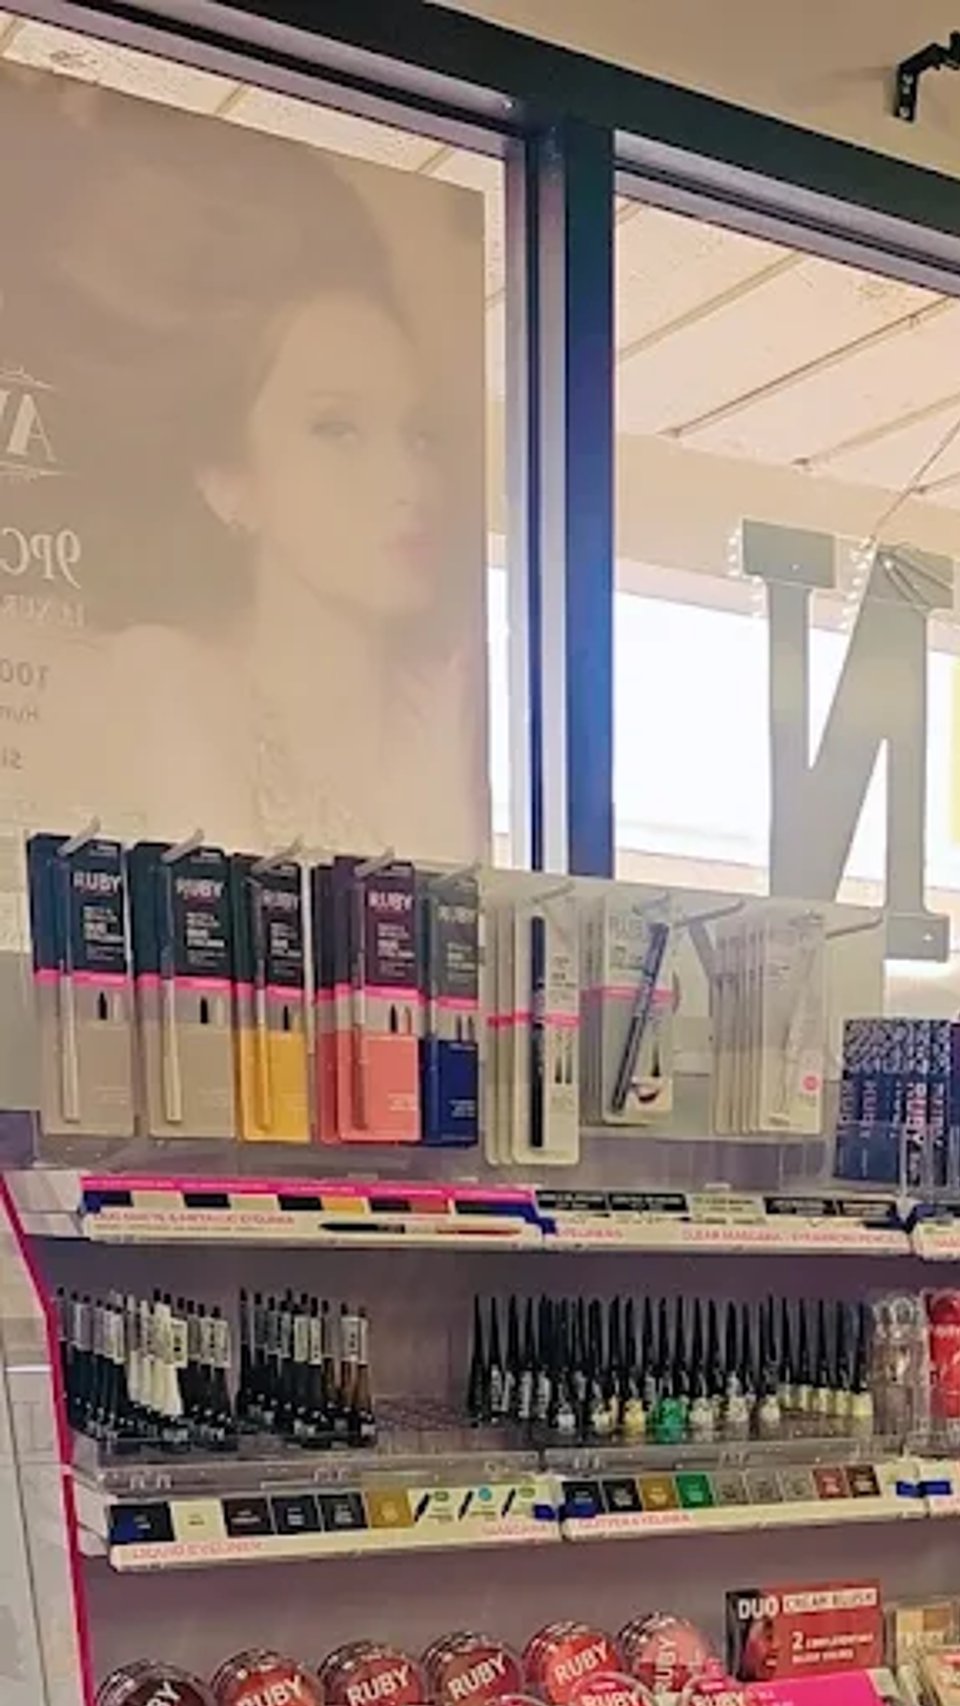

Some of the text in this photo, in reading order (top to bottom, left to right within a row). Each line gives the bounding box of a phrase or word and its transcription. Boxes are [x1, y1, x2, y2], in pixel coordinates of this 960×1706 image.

[73, 871, 122, 893] RUBY
[175, 878, 224, 898] RUBY
[369, 891, 412, 912] RUBY
[738, 1596, 779, 1620] DUO
[791, 1630, 804, 1651] 2
[554, 1642, 609, 1686] RUBY
[447, 1656, 506, 1701] RUBY
